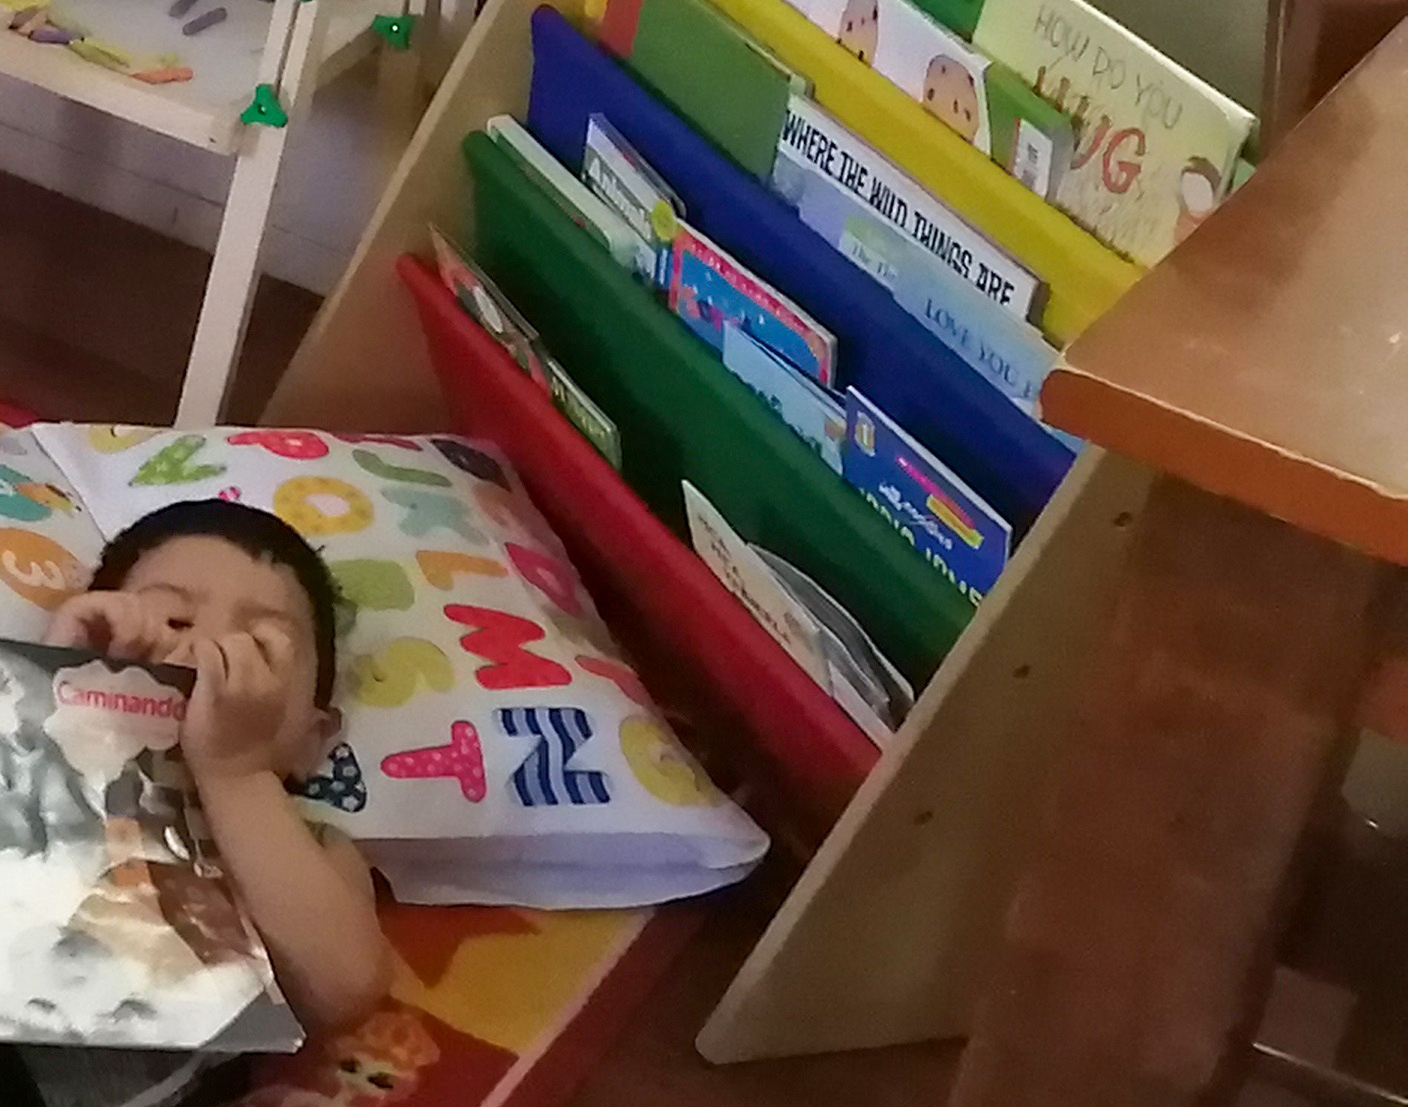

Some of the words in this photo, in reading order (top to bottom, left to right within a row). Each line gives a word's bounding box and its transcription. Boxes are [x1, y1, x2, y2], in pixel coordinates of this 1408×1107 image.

[1034, 5, 1091, 63] HOW
[1092, 45, 1127, 90] DO
[1135, 73, 1184, 130] YOU
[782, 109, 839, 177] WHERE
[840, 149, 867, 195] THE
[870, 176, 909, 228] WILD
[913, 210, 974, 279] THINGS
[976, 262, 1015, 306] ARE
[924, 297, 969, 344] LOVE
[977, 346, 1021, 388] YOU
[57, 678, 185, 723] Caminando
[380, 719, 488, 804] T
